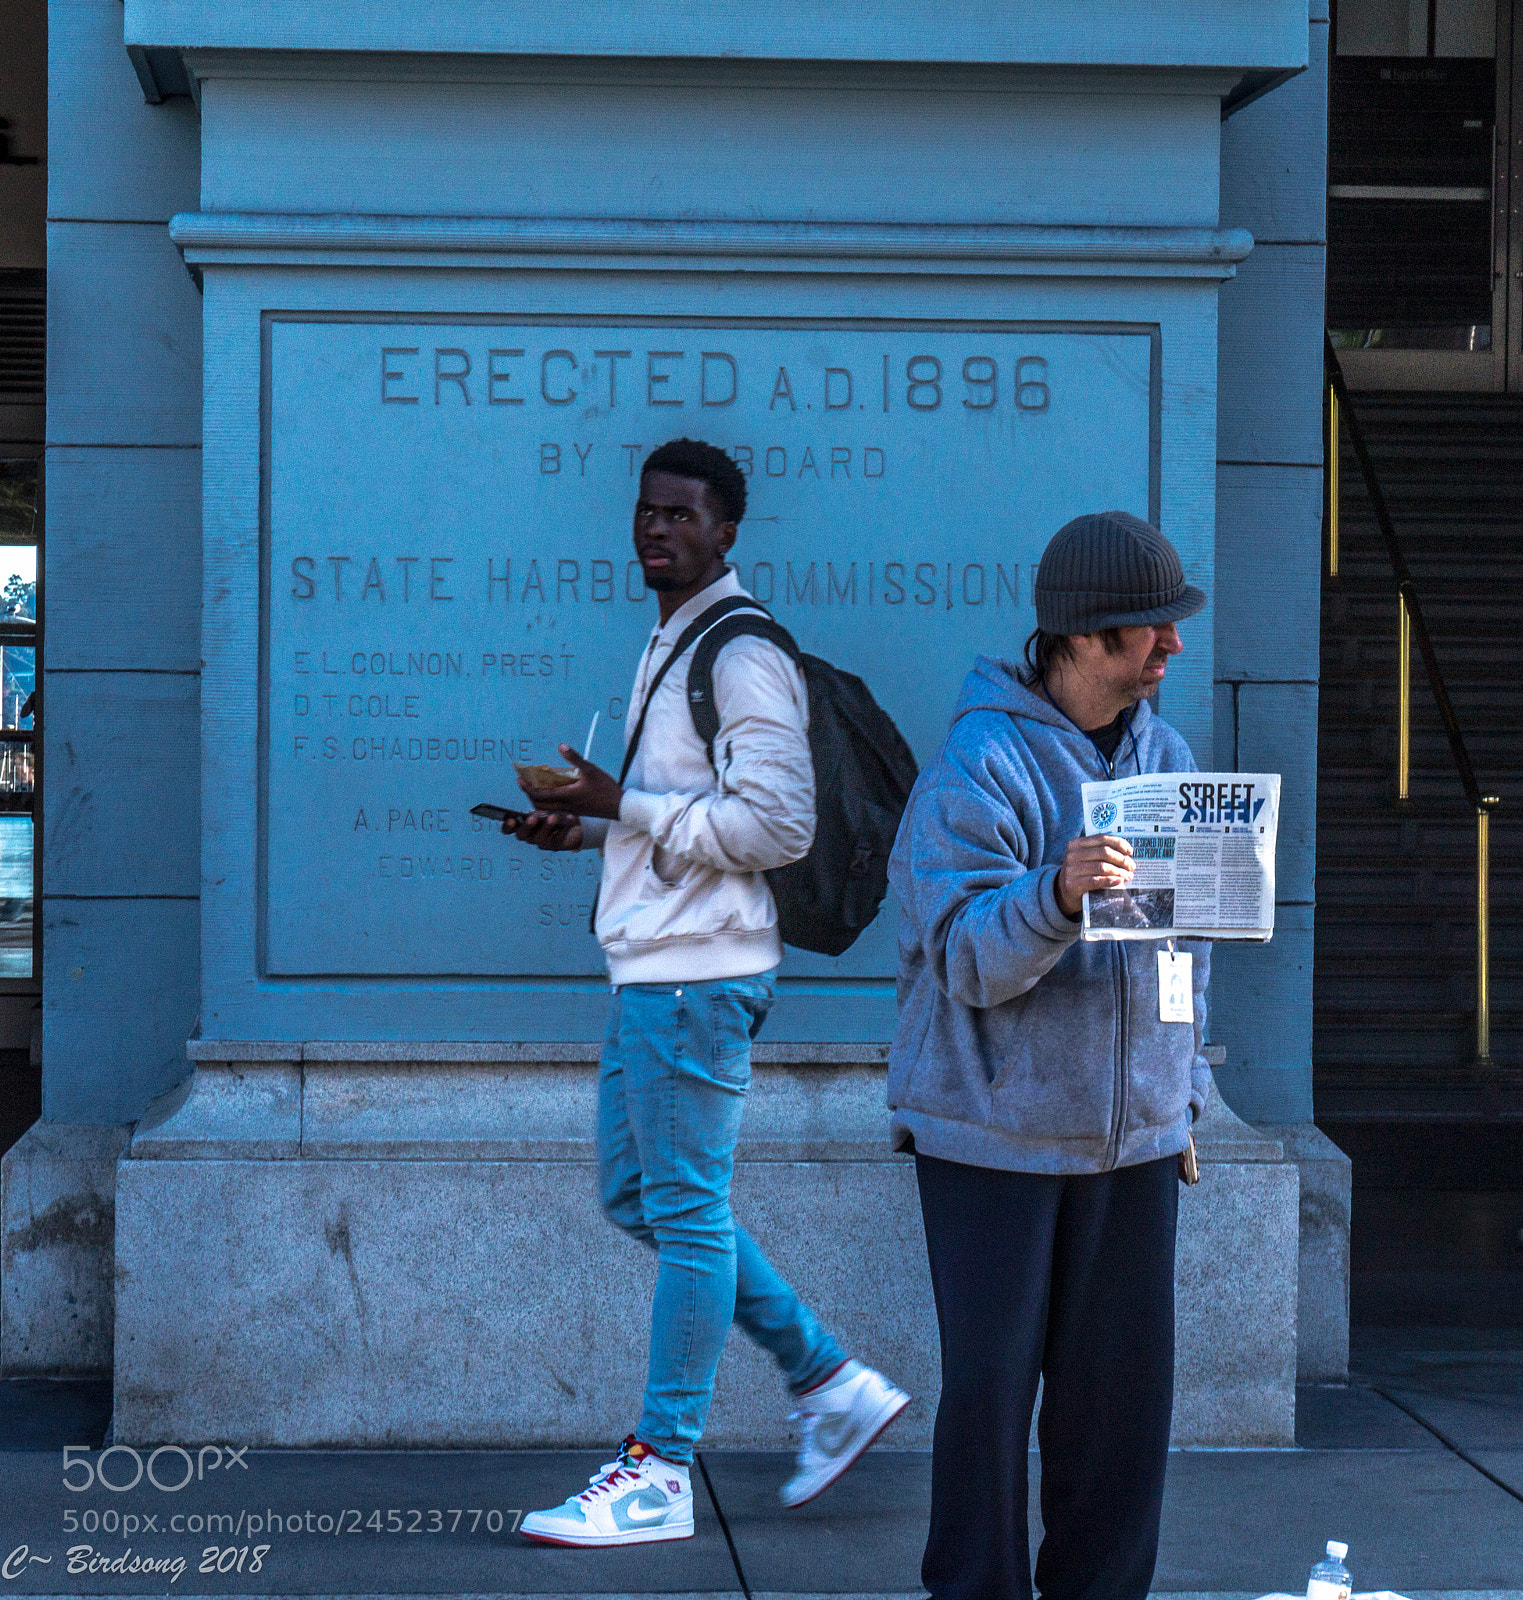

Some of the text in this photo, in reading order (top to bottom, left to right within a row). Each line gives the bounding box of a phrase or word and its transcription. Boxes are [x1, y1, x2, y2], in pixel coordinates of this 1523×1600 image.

[381, 346, 739, 406] ERECTED
[540, 443, 594, 477] BY
[734, 445, 885, 479] BOARD
[290, 556, 454, 602] STATE
[487, 557, 648, 603] HARBO
[1178, 782, 1255, 810] STREET
[1164, 837, 1176, 847] KEEP
[379, 856, 493, 881] EDWARD
[539, 858, 598, 883] SWA
[539, 904, 591, 928] SUP
